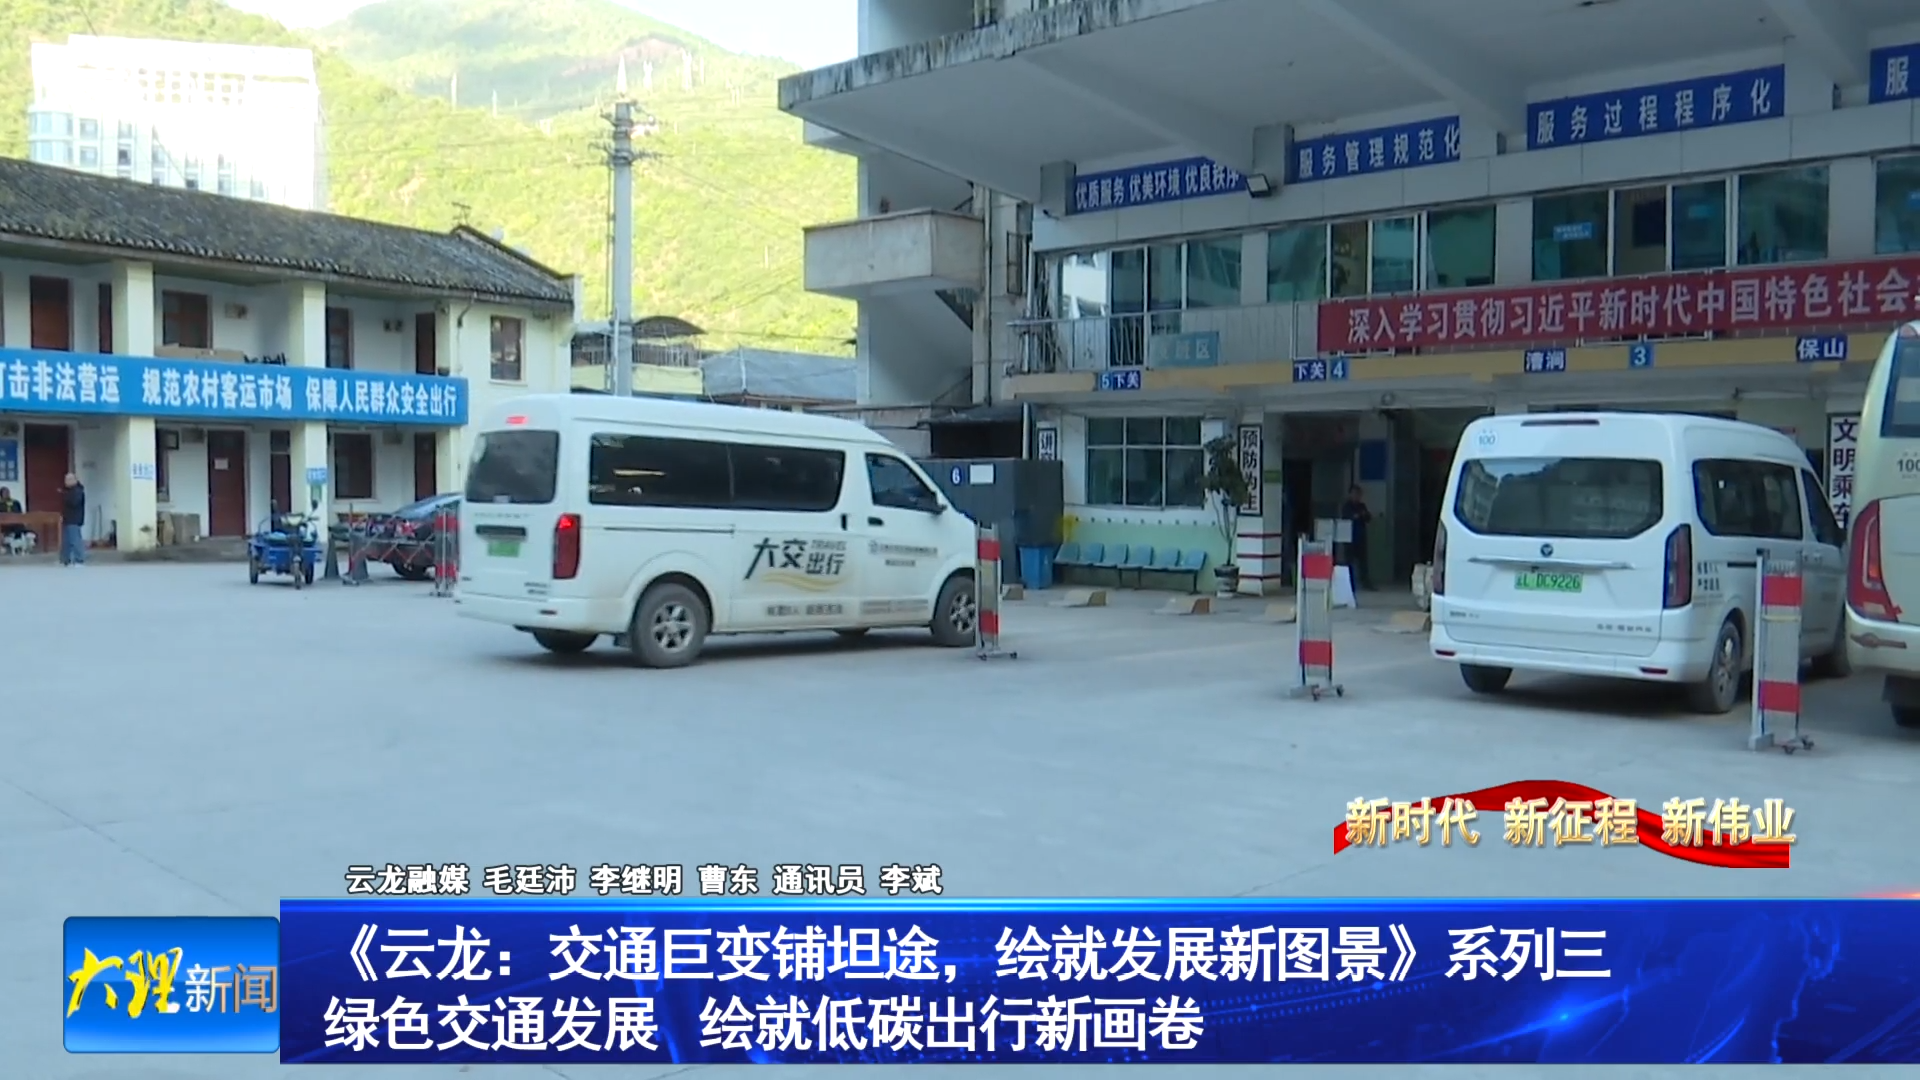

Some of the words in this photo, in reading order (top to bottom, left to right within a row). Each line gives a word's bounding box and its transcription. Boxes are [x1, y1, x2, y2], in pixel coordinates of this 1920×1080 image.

[1537, 77, 1771, 144] 服务过程程序化
[1299, 123, 1460, 178] 服务管理规范化
[1075, 176, 1125, 210] 优质服务
[1130, 167, 1180, 200] 优美环境
[1348, 266, 1920, 344] 深入学习贯彻习近平新时代中国特色社会
[1634, 348, 1646, 366] 3
[1797, 337, 1844, 359] 保山
[1102, 374, 1110, 389] 5
[1114, 371, 1139, 388] 下关
[1295, 362, 1325, 380] 下关
[1332, 363, 1344, 379] 4
[142, 366, 293, 410] 规范农村客运市场
[305, 375, 458, 417] 保障人民群众安全出行
[952, 466, 961, 484] 6
